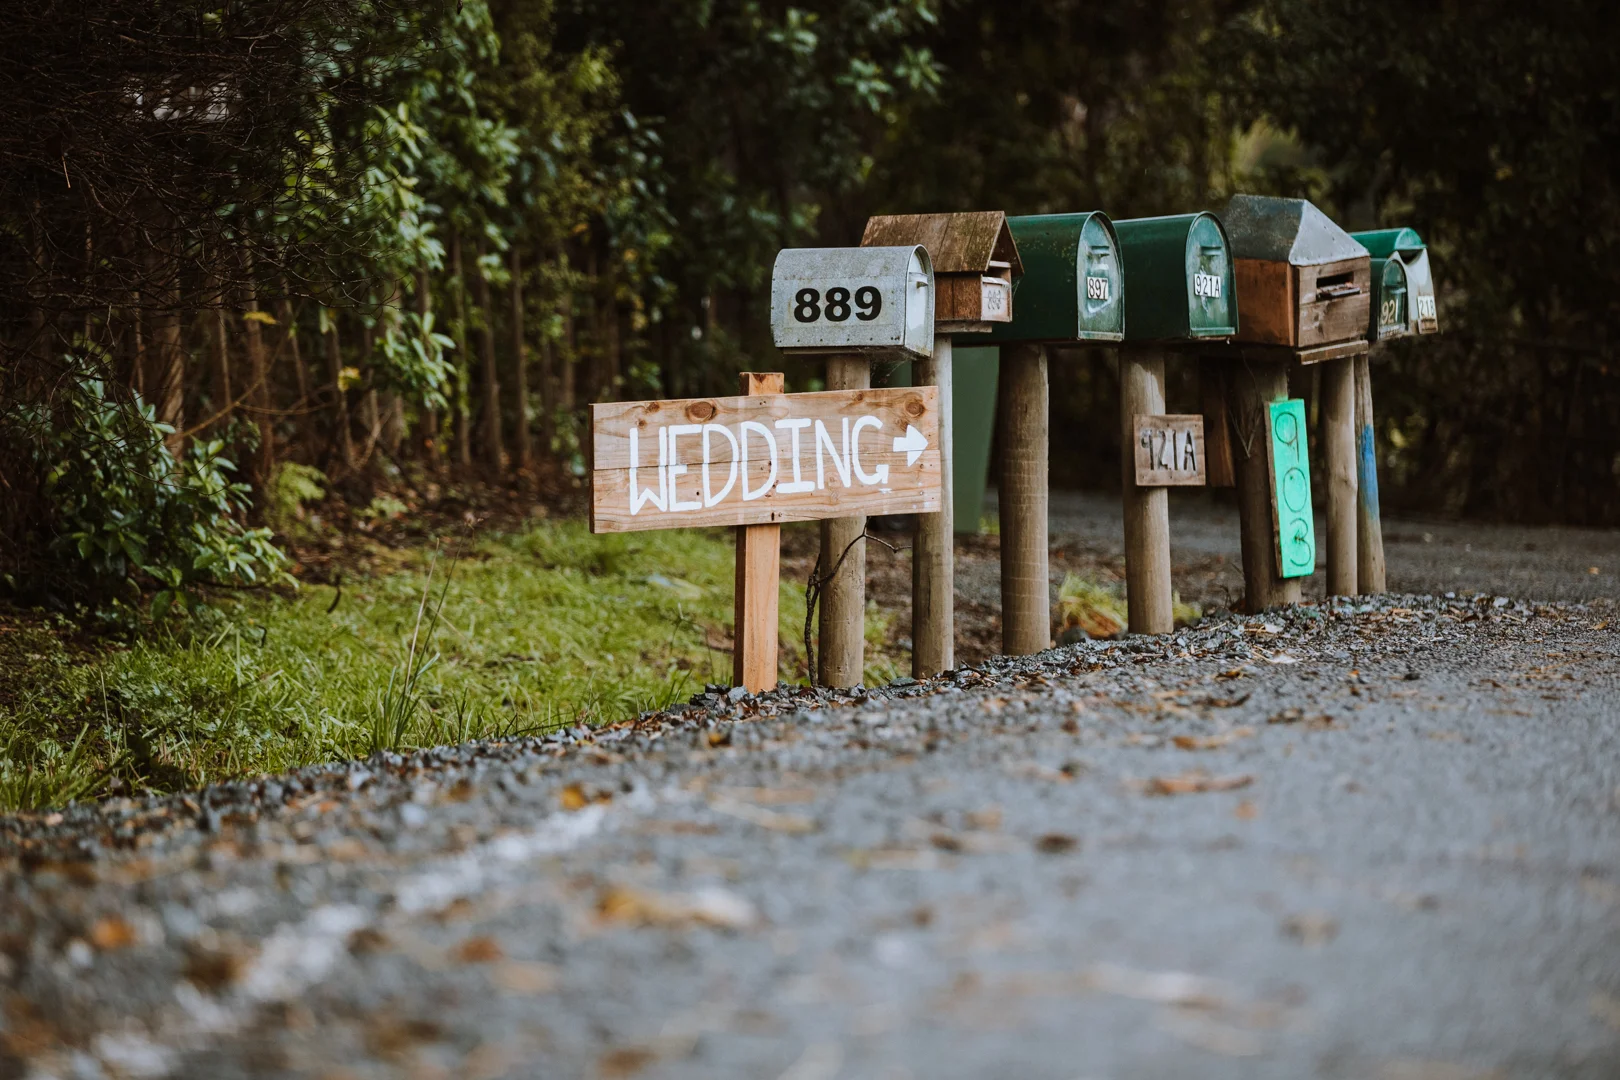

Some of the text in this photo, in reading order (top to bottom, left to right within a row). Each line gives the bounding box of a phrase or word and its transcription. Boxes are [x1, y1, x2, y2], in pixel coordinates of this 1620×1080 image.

[793, 285, 882, 323] 889
[1088, 278, 1108, 299] 897
[1195, 275, 1220, 297] 921A
[629, 415, 890, 516] WEDDING
[1140, 428, 1196, 472] 921A
[1274, 411, 1312, 567] 903
